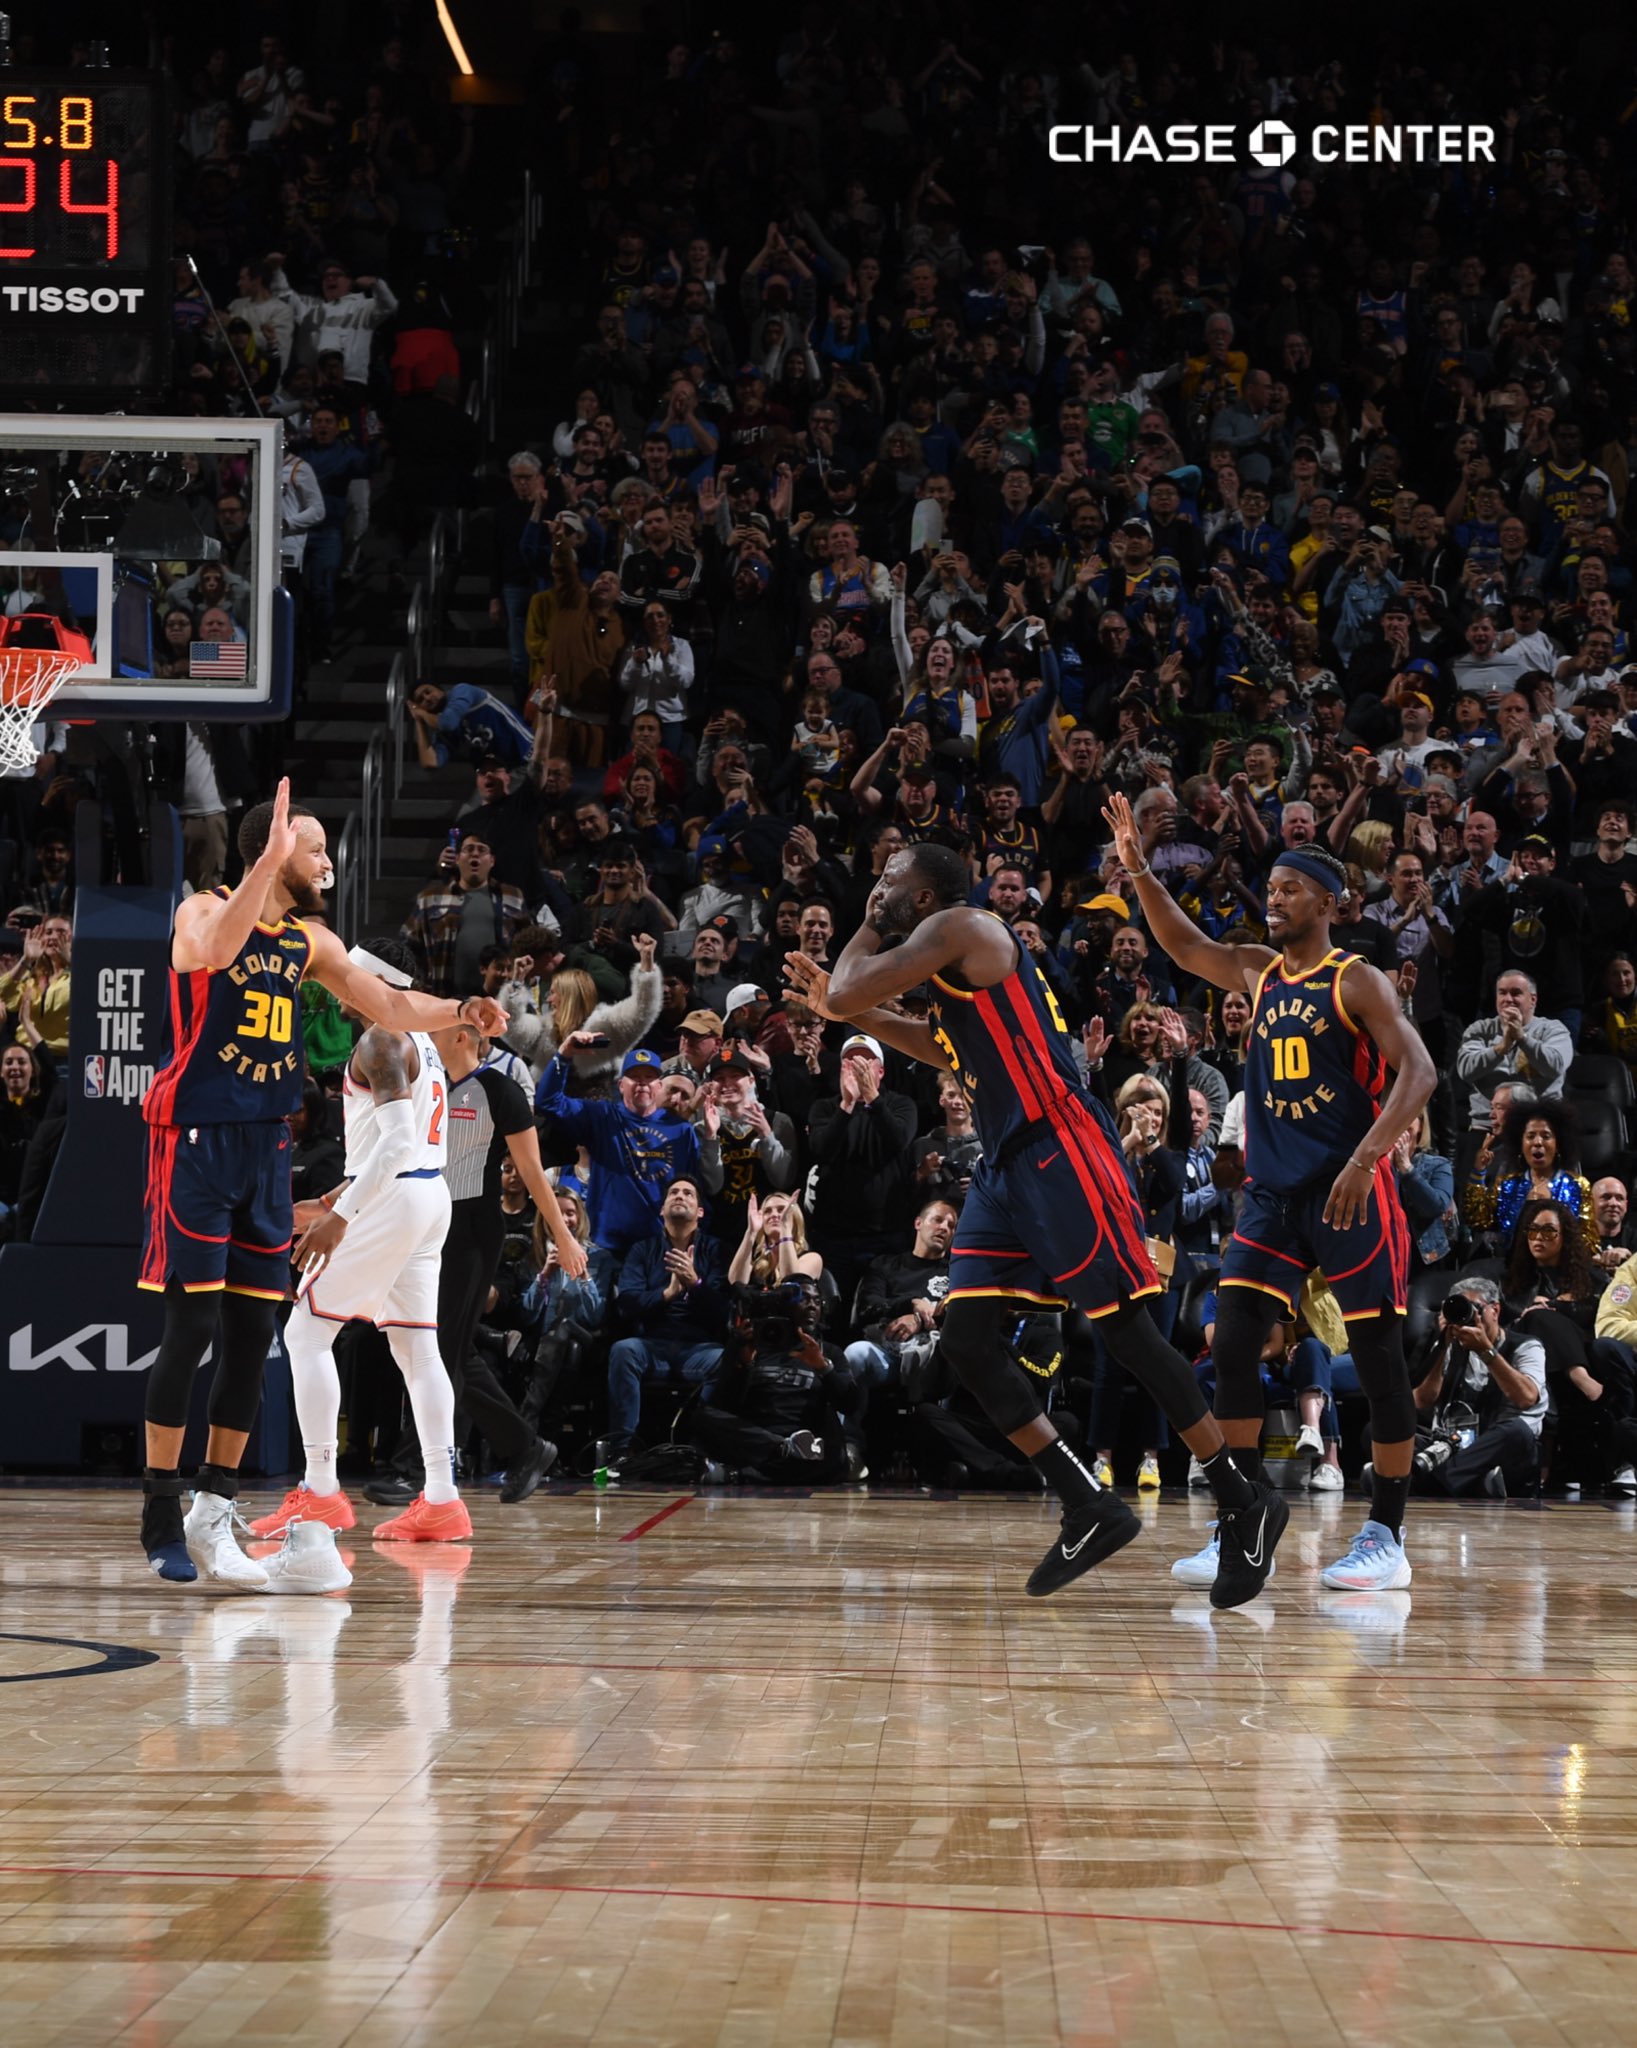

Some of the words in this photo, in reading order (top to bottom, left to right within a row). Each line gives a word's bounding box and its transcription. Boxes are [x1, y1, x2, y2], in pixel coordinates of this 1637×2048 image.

[4, 96, 93, 149] 5.8
[2, 286, 145, 314] TISSOT
[97, 967, 146, 1008] GET
[228, 952, 299, 987] GOLDE
[96, 1012, 145, 1051] THE
[236, 989, 293, 1043] 30
[1256, 998, 1329, 1040] GOLDEN
[217, 1042, 298, 1083] STATE
[1271, 1036, 1310, 1081] 10
[106, 1056, 155, 1106] App
[1264, 1083, 1336, 1120] STATE
[427, 1081, 444, 1145] 2
[450, 1109, 476, 1118] Emirates
